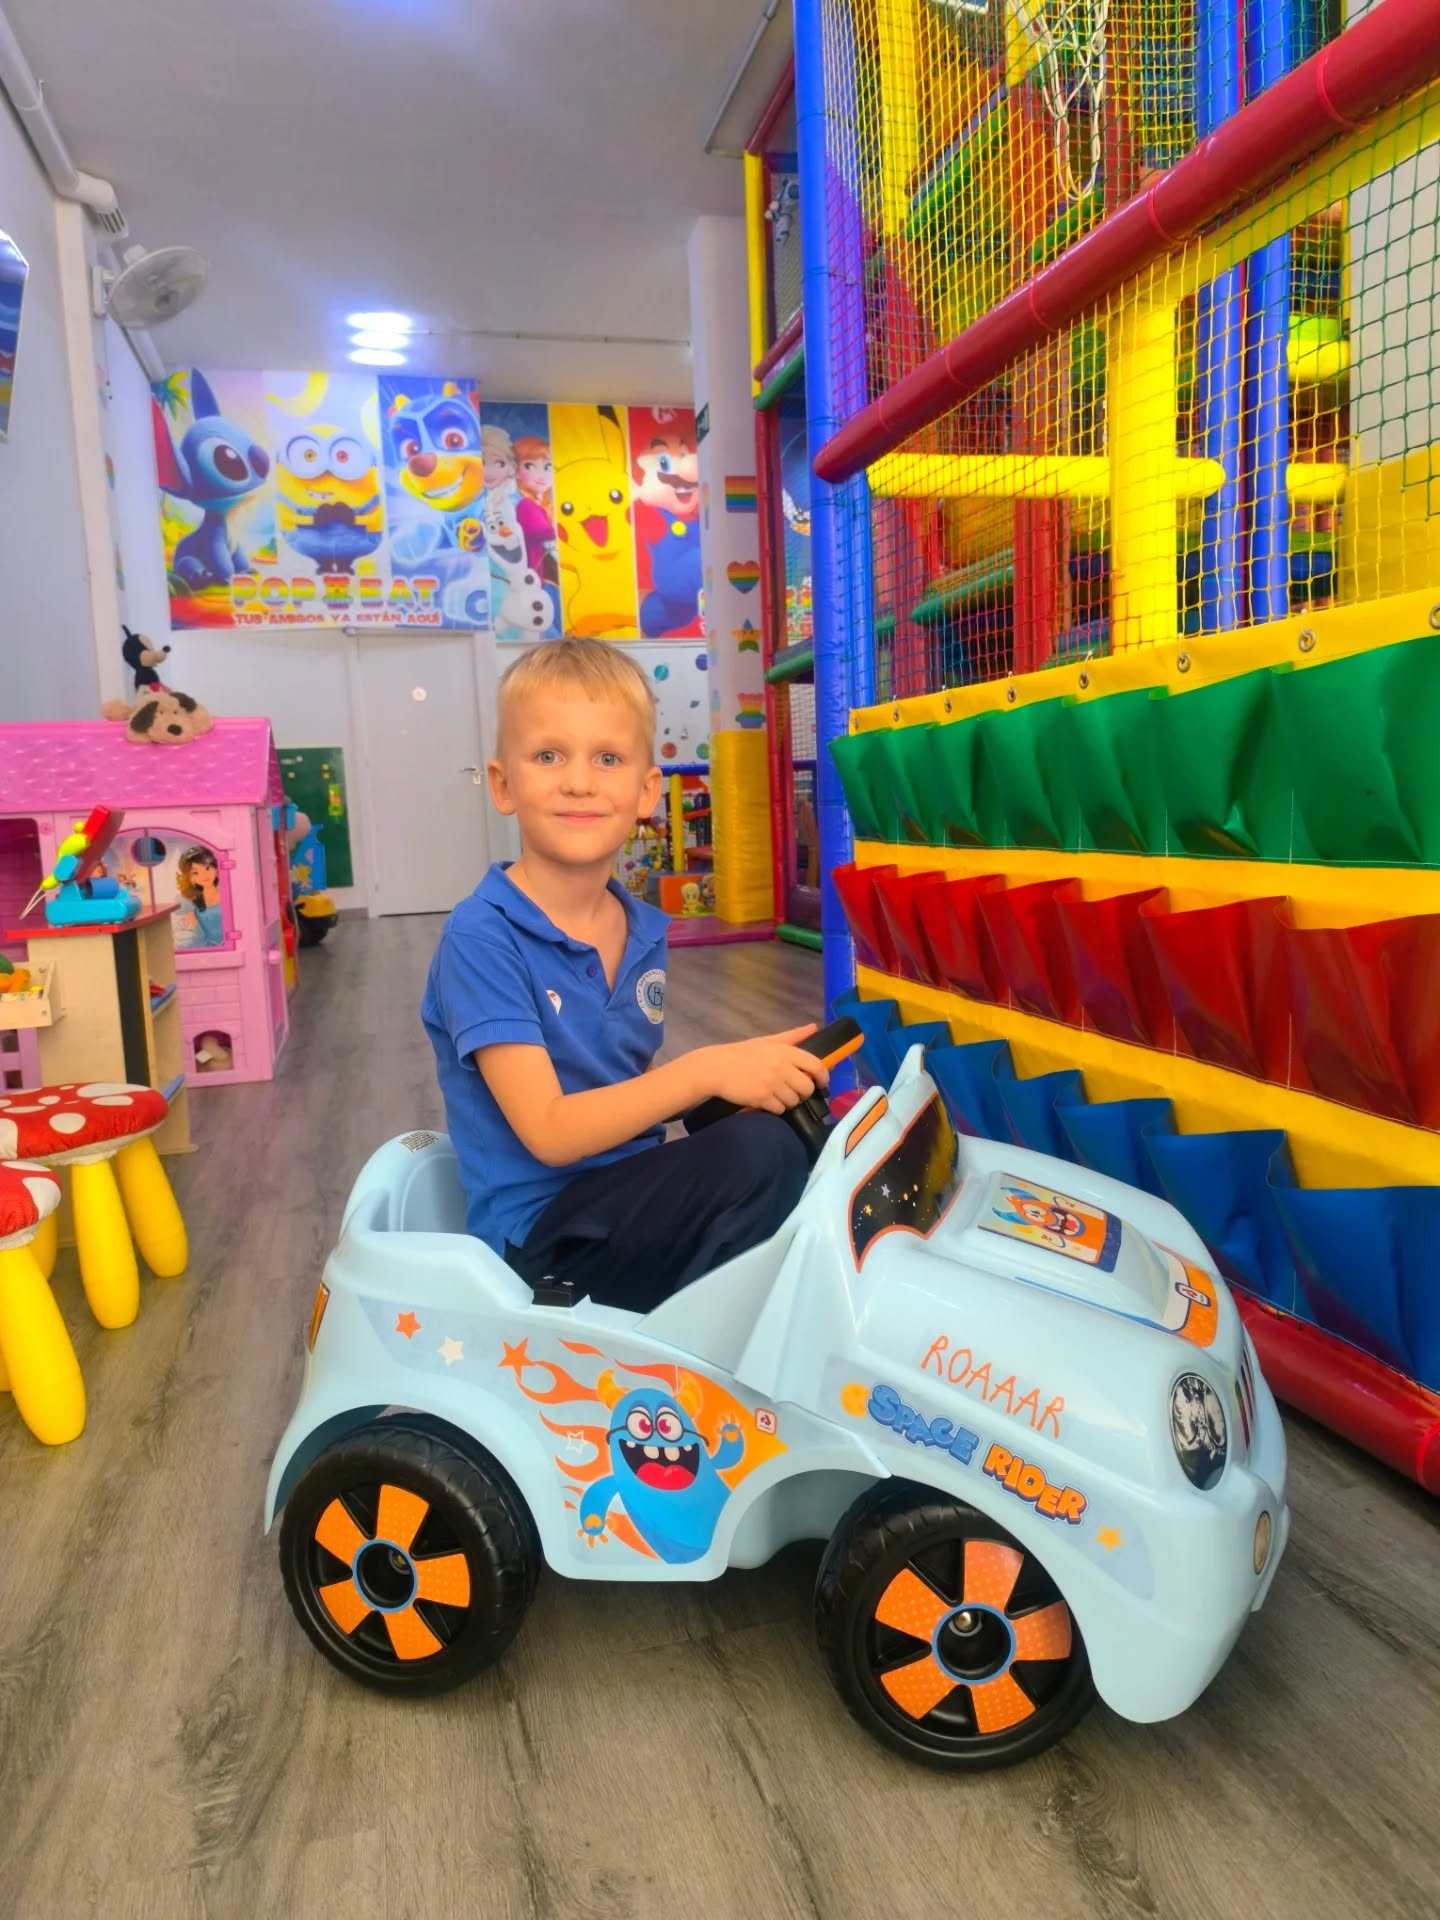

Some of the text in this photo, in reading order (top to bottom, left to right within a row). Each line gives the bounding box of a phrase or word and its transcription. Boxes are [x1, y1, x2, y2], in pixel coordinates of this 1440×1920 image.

[235, 613, 263, 624] TUS
[268, 613, 325, 625] AMIGOS
[330, 613, 350, 623] YA
[920, 1335, 1066, 1440] ROAAAR
[867, 1384, 1088, 1525] SPACE RIDER
